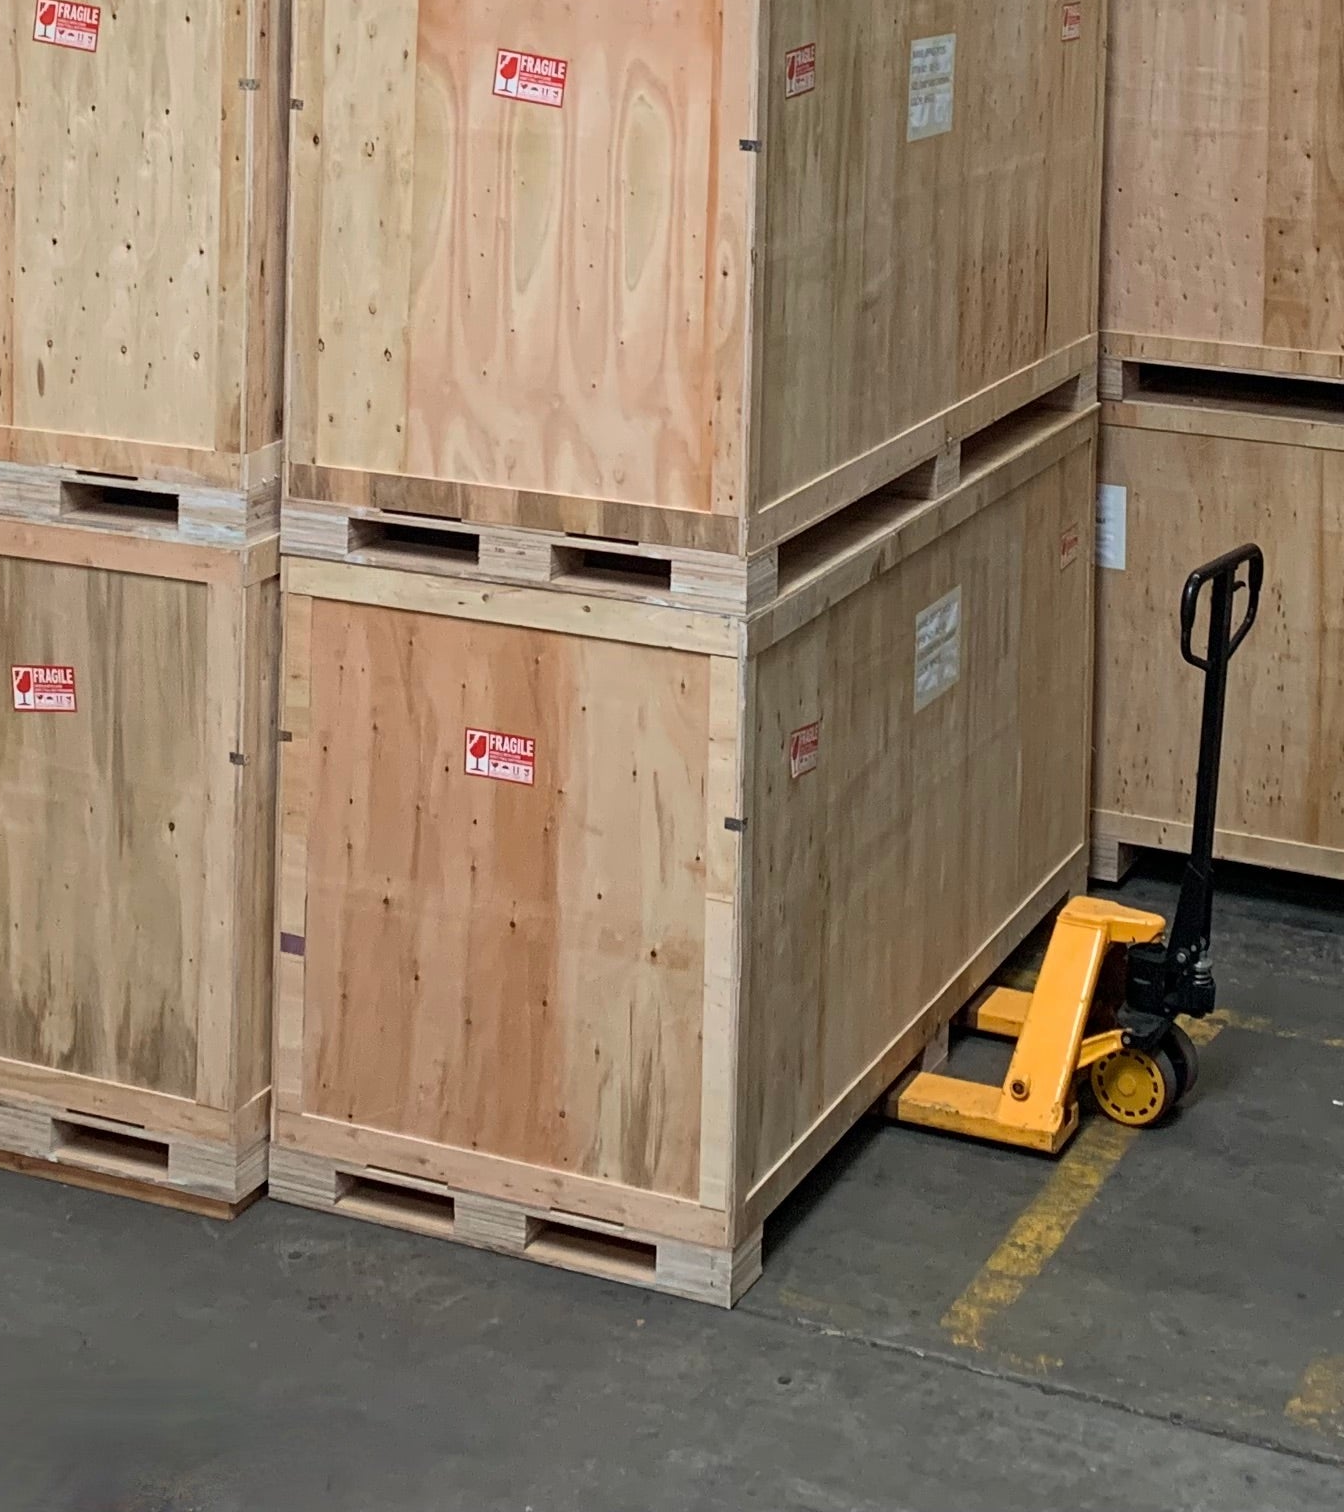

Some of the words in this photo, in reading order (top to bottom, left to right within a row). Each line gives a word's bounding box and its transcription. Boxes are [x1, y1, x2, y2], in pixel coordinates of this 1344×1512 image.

[58, 3, 99, 24] FRAGILE
[521, 57, 565, 78] FRAGILE
[34, 669, 73, 684] FRAGILE
[490, 737, 533, 756] FRAGILE
